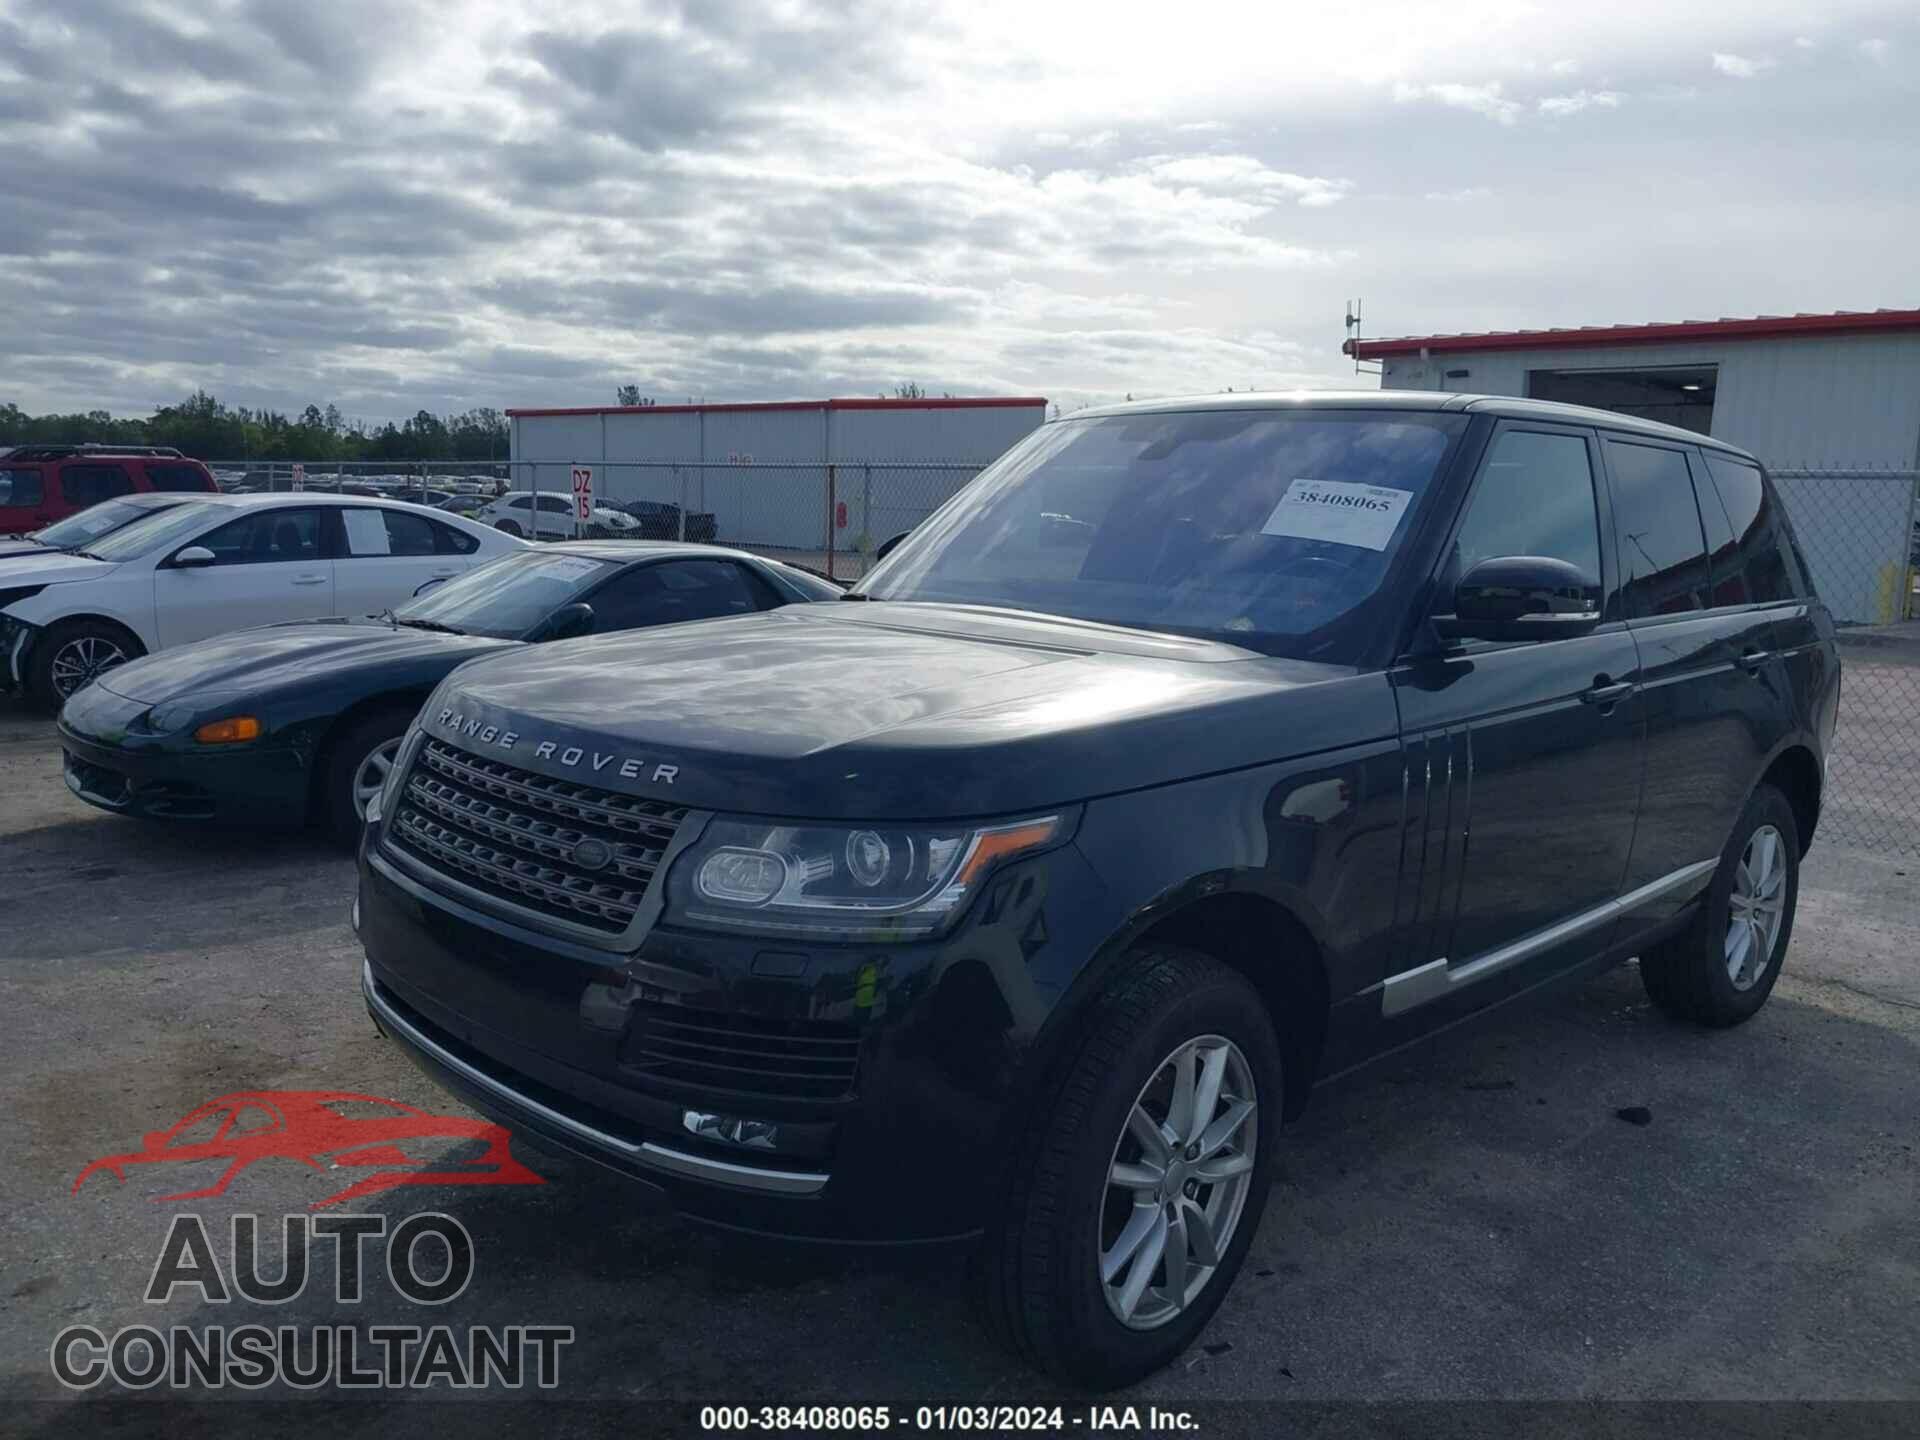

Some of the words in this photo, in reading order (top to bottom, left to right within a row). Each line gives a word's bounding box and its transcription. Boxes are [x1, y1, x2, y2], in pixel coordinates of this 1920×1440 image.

[573, 470, 591, 493] DZ
[578, 496, 590, 519] 15
[1293, 491, 1392, 512] 38408065
[438, 708, 520, 750] RANGE
[535, 740, 680, 785] ROVER
